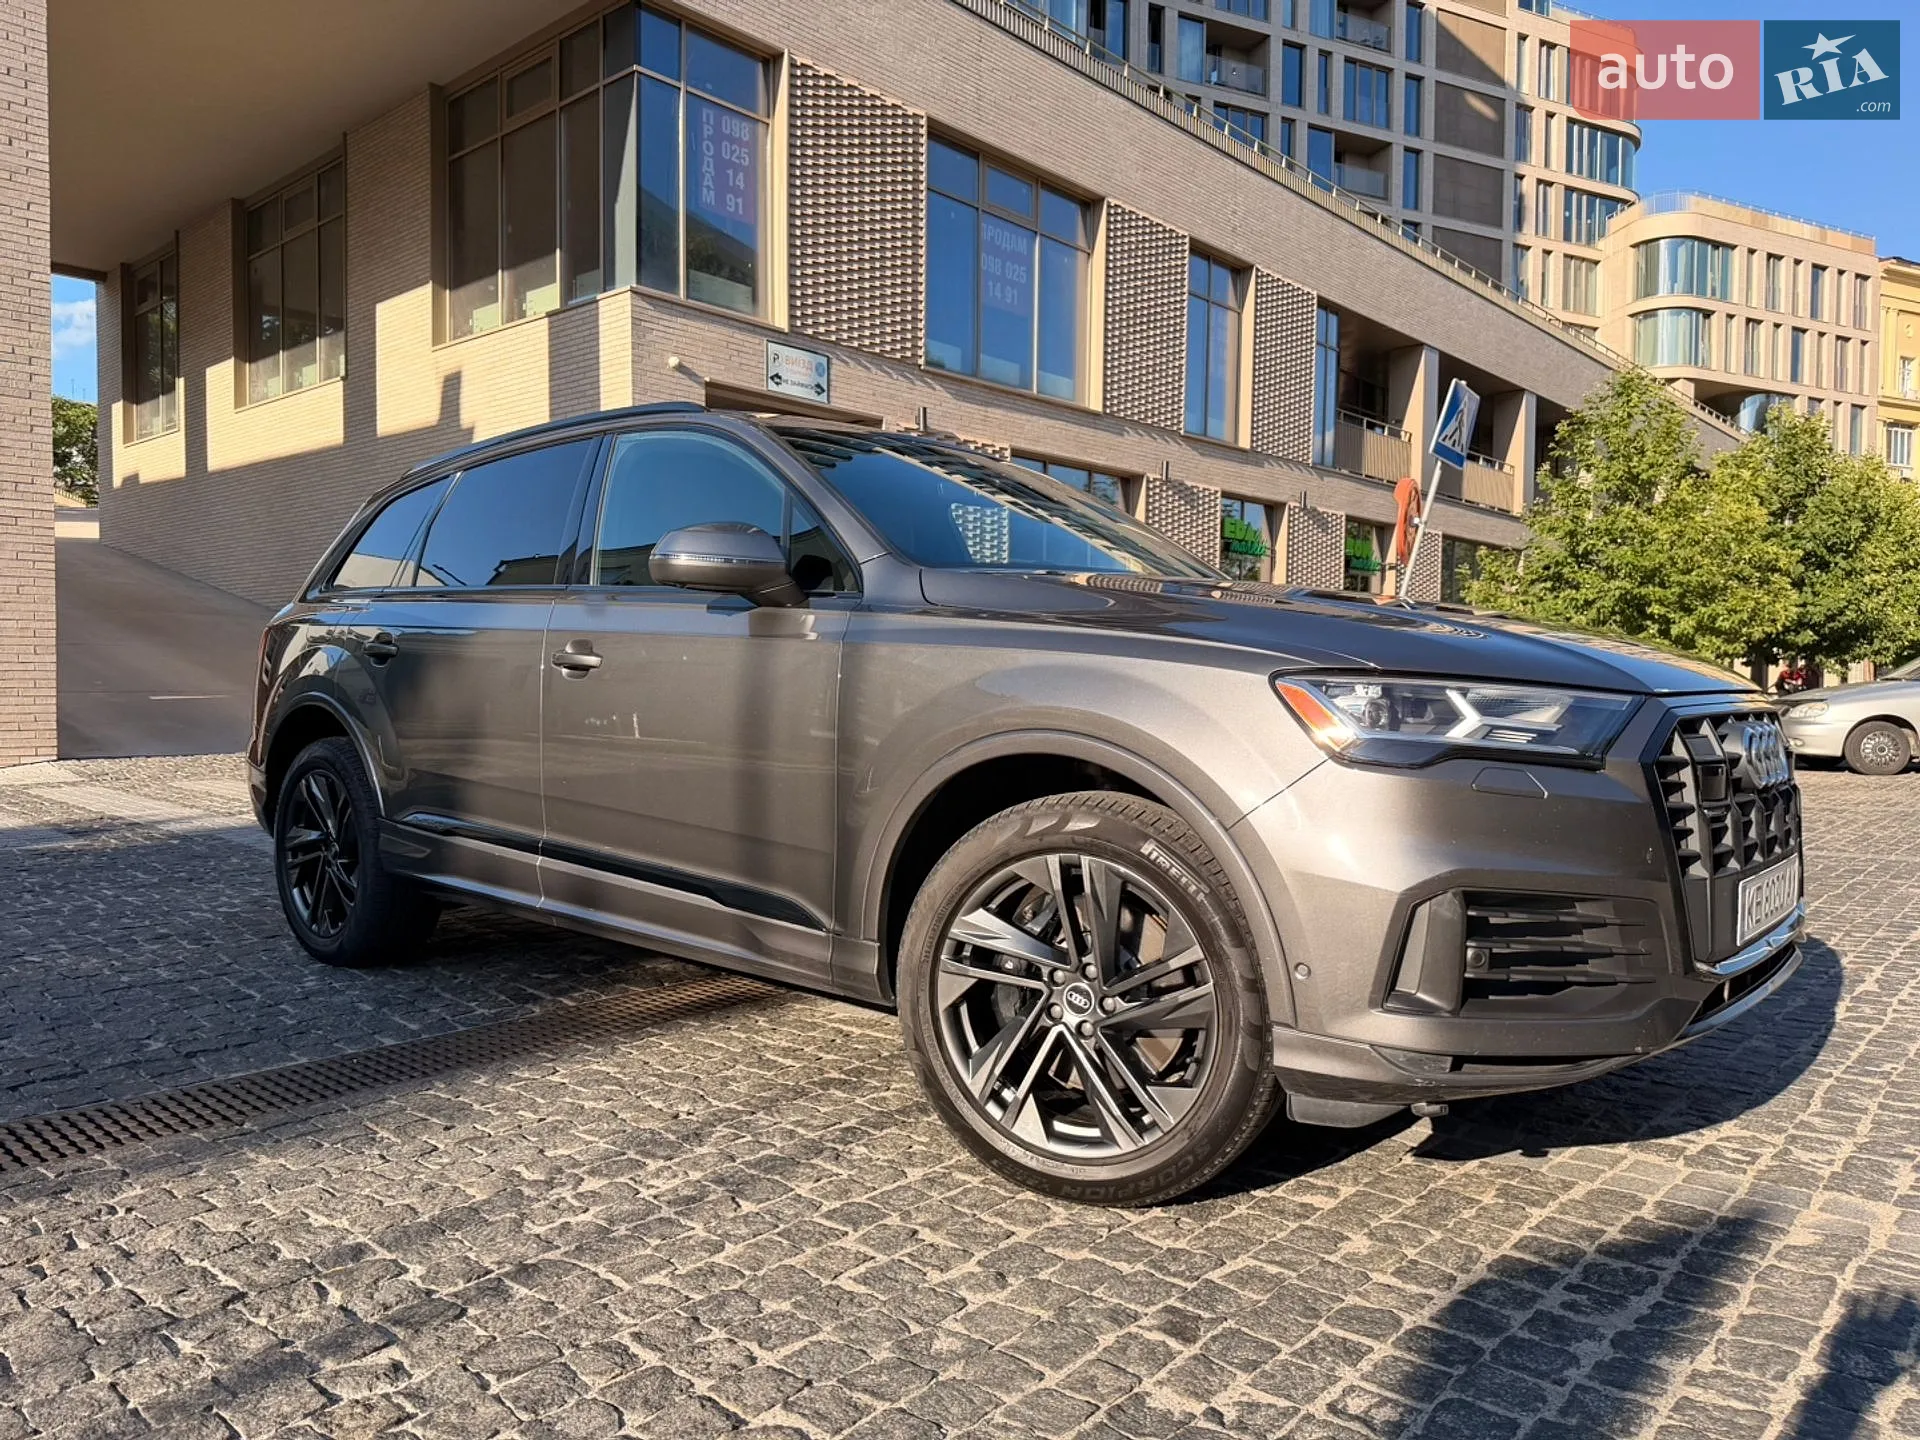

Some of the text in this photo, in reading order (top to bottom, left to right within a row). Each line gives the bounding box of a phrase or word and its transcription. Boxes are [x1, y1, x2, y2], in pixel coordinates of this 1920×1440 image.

[721, 115, 749, 141] 098
[702, 107, 716, 206] ПРОДАМ
[721, 140, 749, 166] 025
[726, 168, 744, 190] 14
[726, 194, 743, 215] 91
[982, 252, 1027, 284] 098 025
[988, 280, 1018, 304] 14 91
